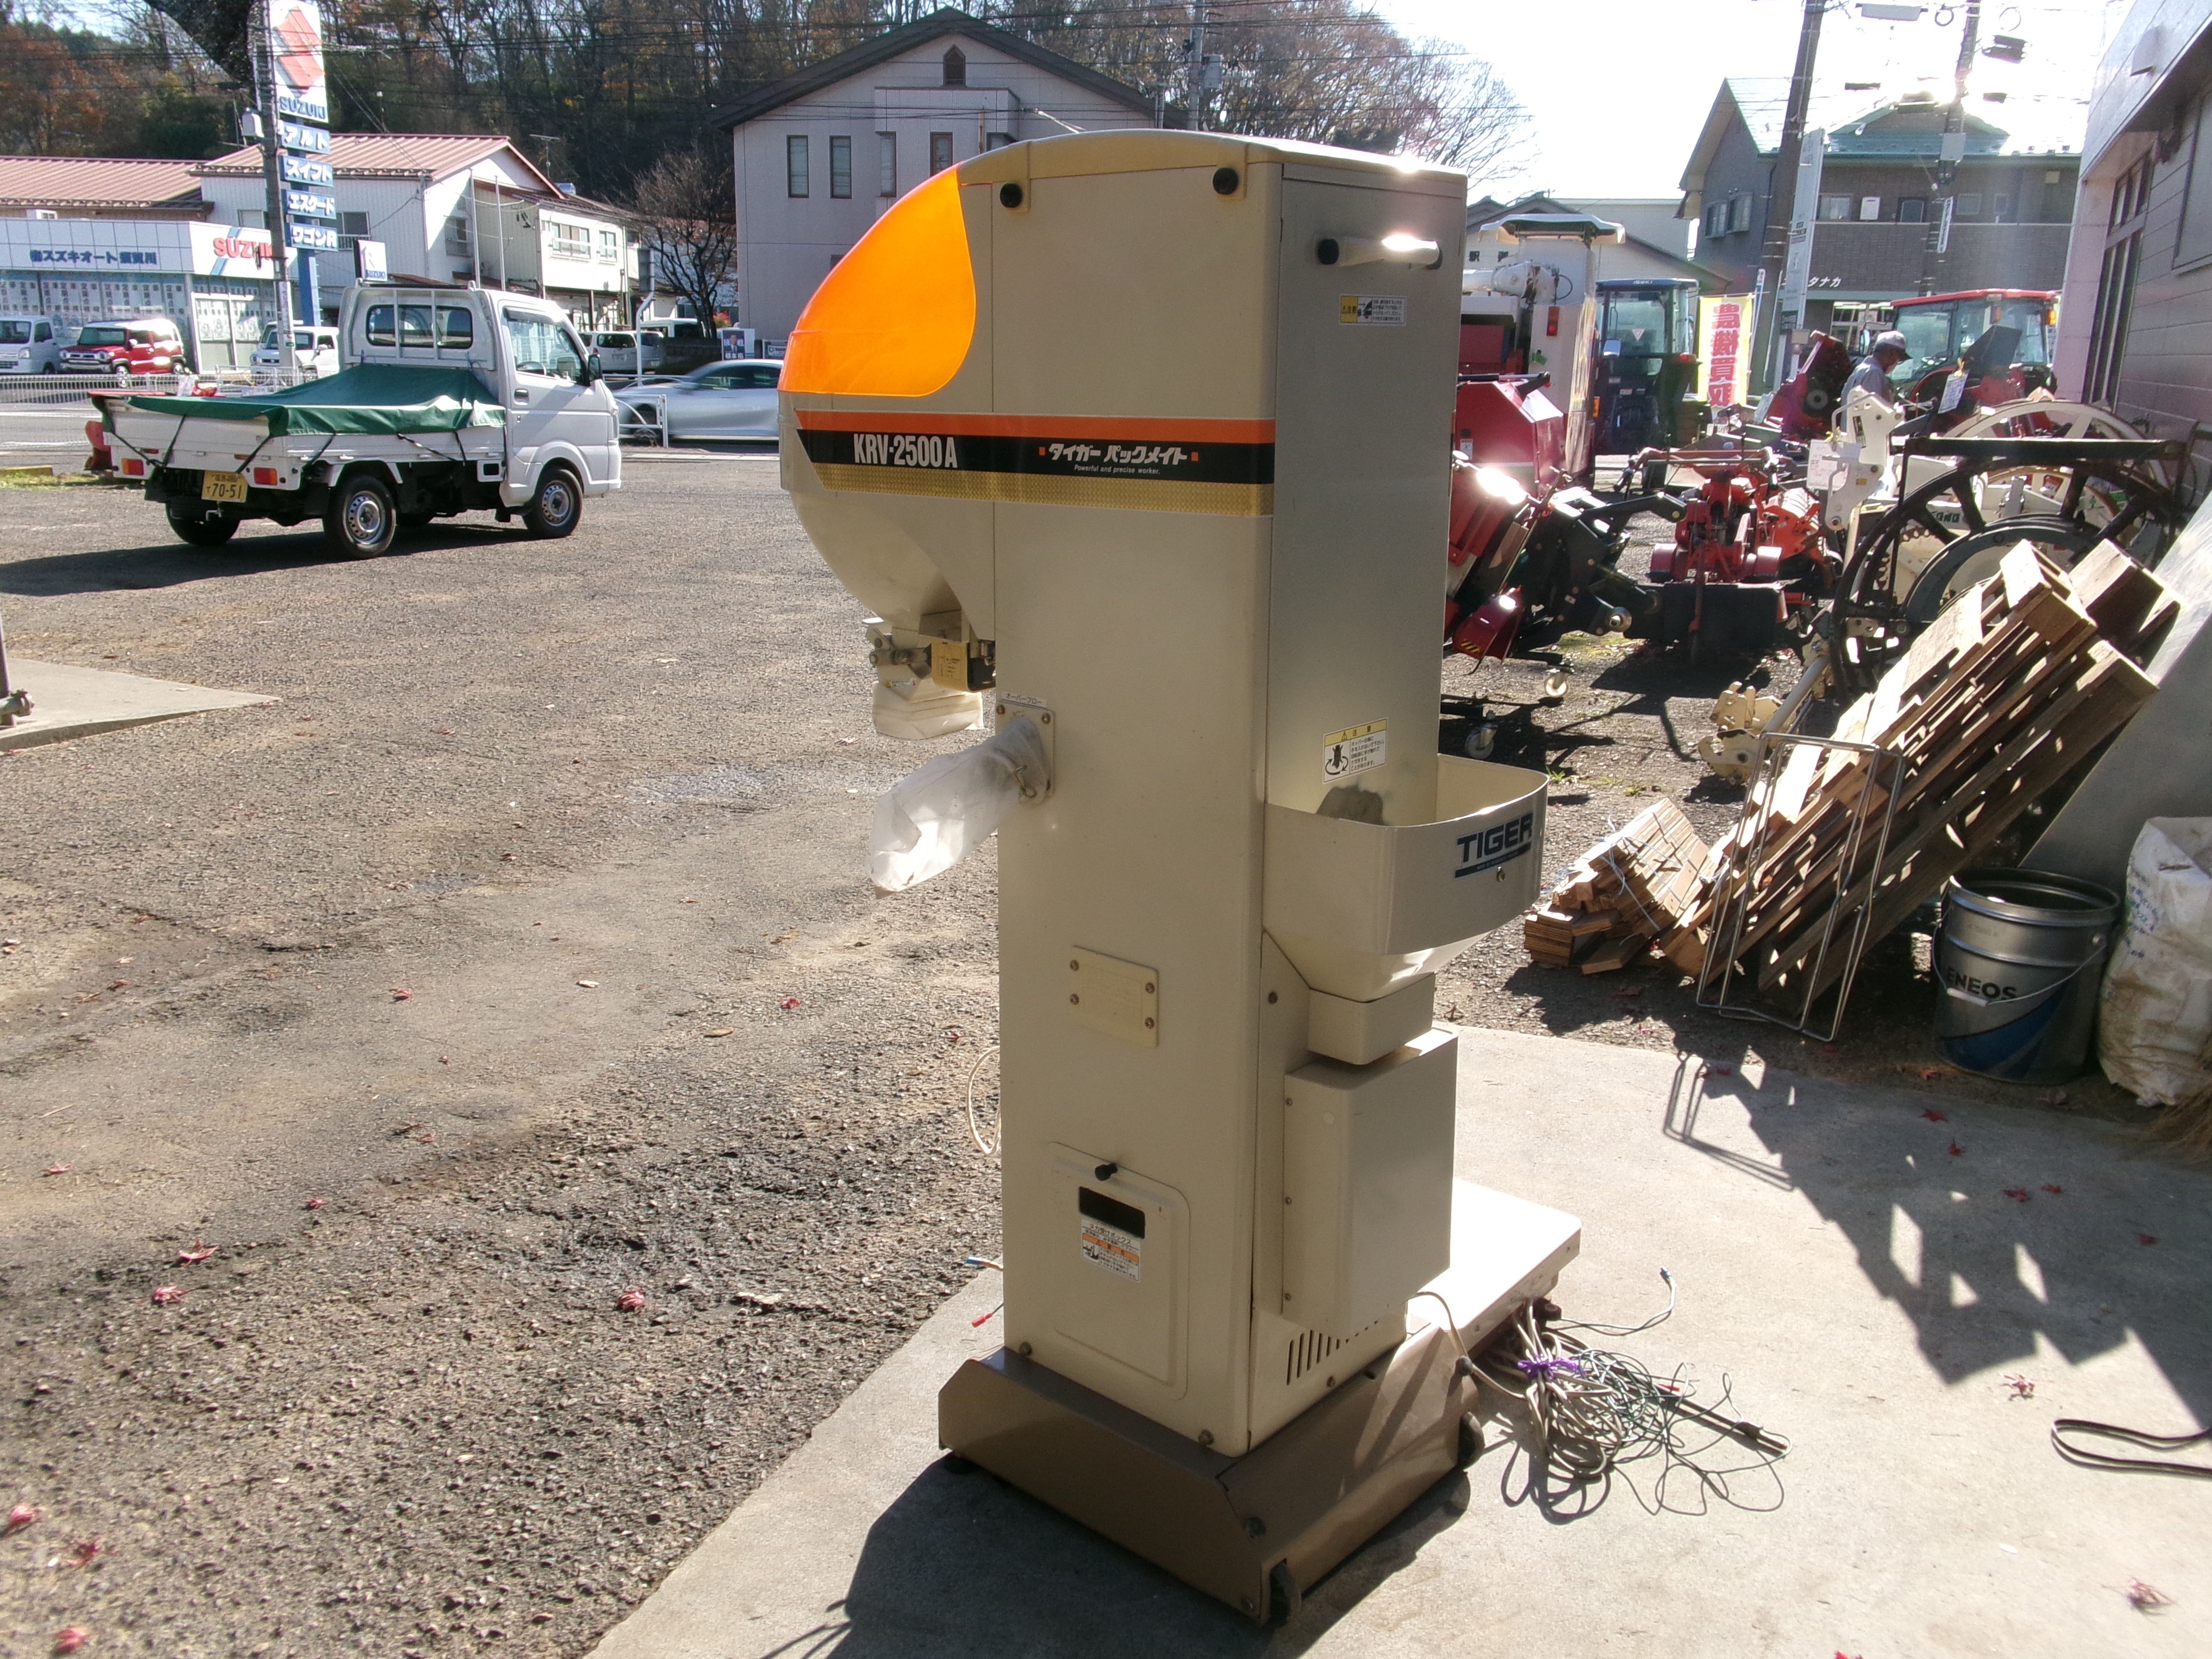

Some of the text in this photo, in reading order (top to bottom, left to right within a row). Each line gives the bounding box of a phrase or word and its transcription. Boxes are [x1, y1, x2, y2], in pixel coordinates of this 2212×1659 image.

[279, 96, 326, 120] SUZUKI
[285, 126, 328, 150] アルト
[287, 159, 333, 182] スイフト
[289, 193, 335, 215] エスクード
[292, 227, 337, 248] ワゴンR
[853, 433, 958, 469] KRV-2500A
[1048, 443, 1188, 465] タイガー パックメイト
[1074, 464, 1098, 472] Powerful
[212, 483, 242, 499] 70-51
[1457, 812, 1534, 863] TIGER
[1947, 966, 2016, 1000] ENEOS
